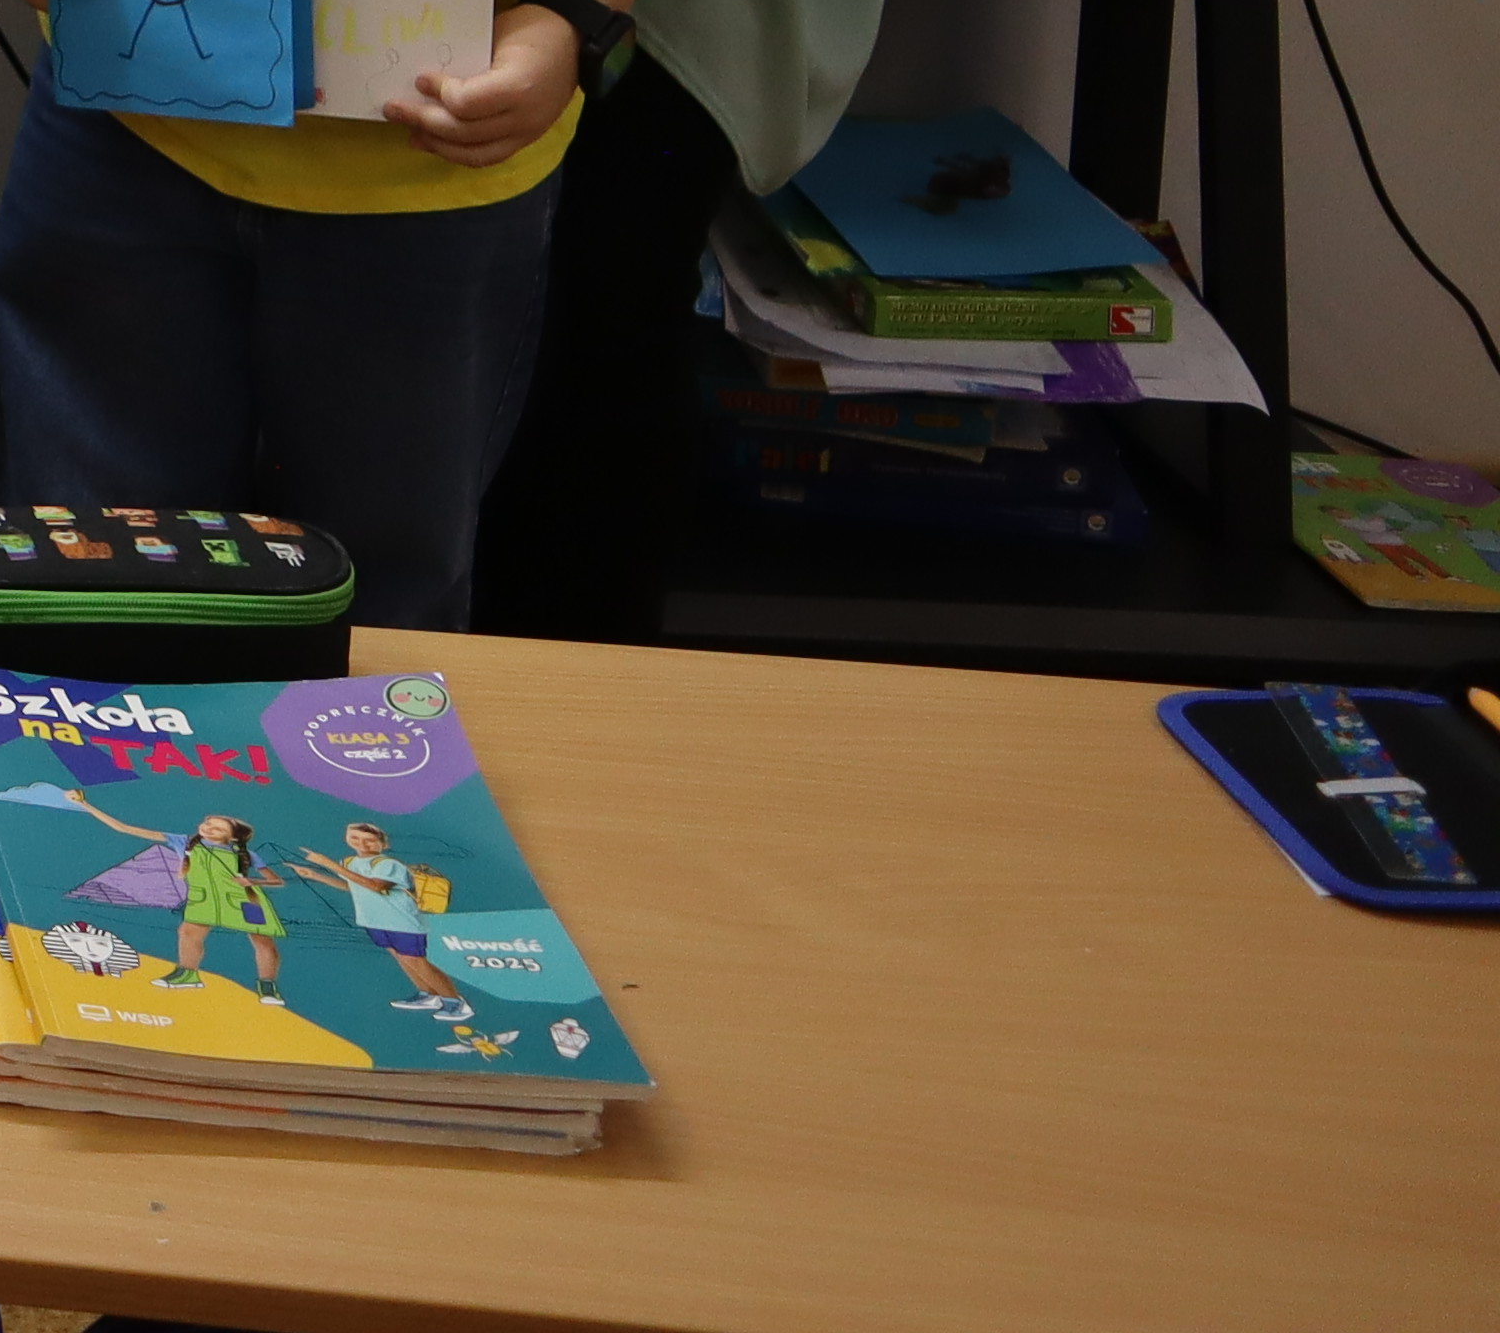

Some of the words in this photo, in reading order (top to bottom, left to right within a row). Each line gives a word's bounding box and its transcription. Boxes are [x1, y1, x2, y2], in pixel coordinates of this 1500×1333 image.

[18, 717, 85, 746] na
[303, 705, 426, 738] PODRĘCZNIK
[326, 731, 391, 746] KLASA
[394, 732, 411, 745] 3
[90, 735, 272, 786] TAK!
[393, 749, 408, 760] 2
[441, 935, 546, 955] Nowość
[465, 954, 542, 973] 2025
